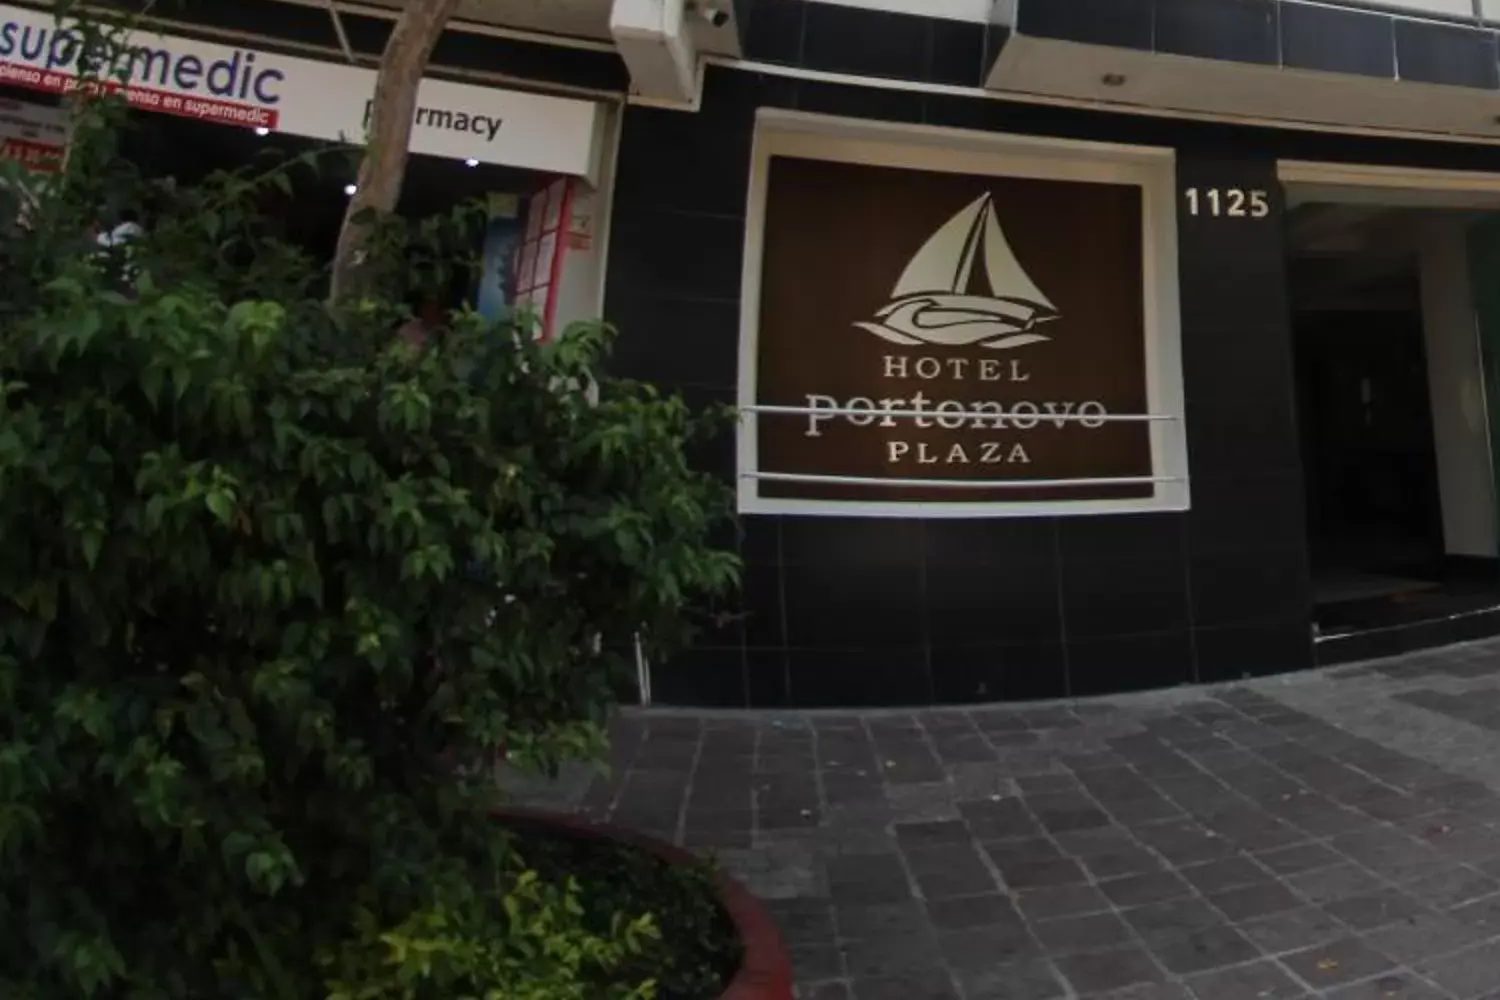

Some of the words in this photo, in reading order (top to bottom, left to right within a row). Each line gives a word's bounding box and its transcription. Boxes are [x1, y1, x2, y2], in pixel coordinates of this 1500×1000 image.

[162, 93, 182, 109] en
[184, 98, 271, 125] supermedic
[1184, 187, 1269, 217] 1125
[883, 356, 1030, 381] HOTEL
[804, 391, 1107, 437] portonovo
[887, 441, 1031, 464] PLAZA
